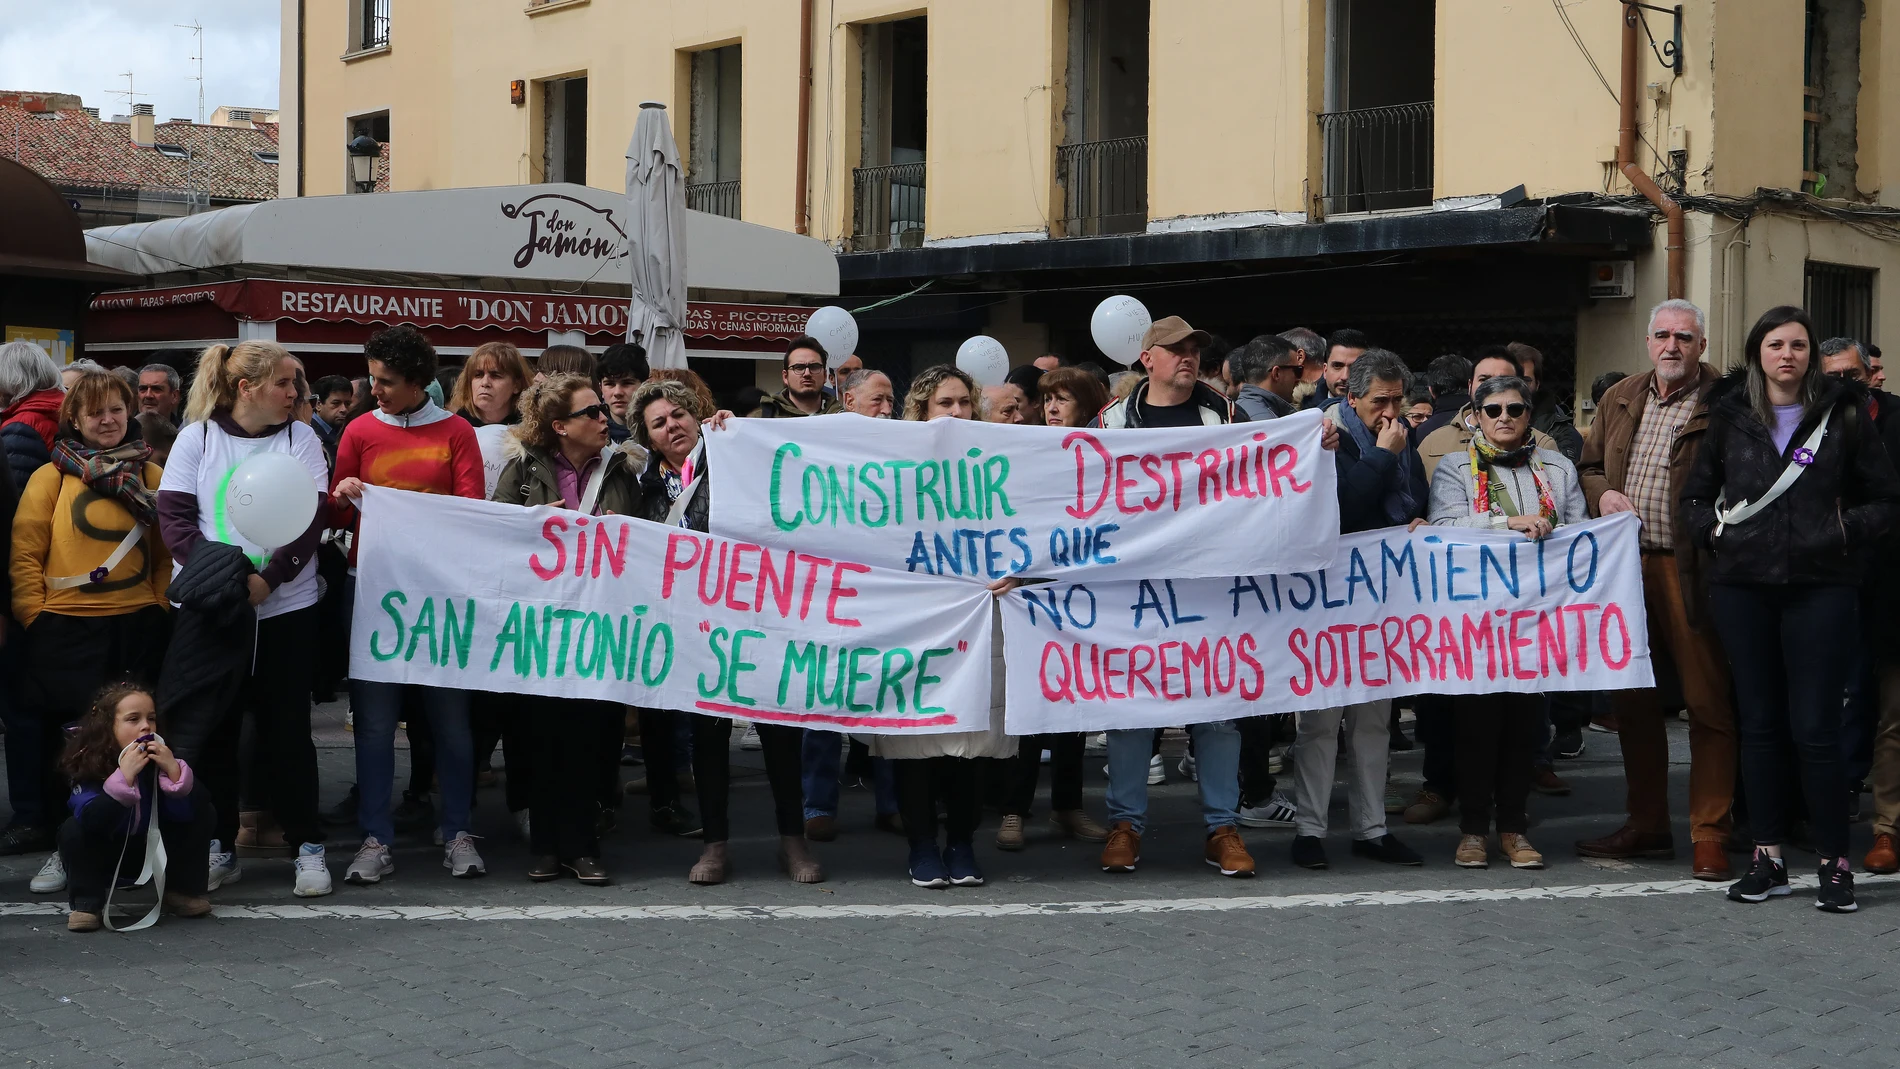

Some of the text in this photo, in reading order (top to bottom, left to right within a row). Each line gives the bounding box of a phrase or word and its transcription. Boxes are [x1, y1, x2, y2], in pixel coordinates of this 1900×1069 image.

[513, 210, 615, 269] Jamón
[546, 209, 576, 233] don
[140, 295, 165, 308] TAPAS
[172, 290, 216, 305] PICOTEOS
[281, 291, 443, 318] RESTAURANTE
[458, 296, 533, 323] "DON
[687, 309, 713, 320] PAS
[729, 311, 809, 323] PICOTEOS
[686, 319, 805, 333] IDAS Y CENAS INFORMALE
[906, 523, 1121, 579] ANTES QUE
[661, 531, 872, 628] PUENTE
[1020, 583, 1097, 631] NO
[1130, 579, 1208, 629] AL
[370, 590, 476, 670] SAN
[1038, 632, 1266, 704] QUEREMOS
